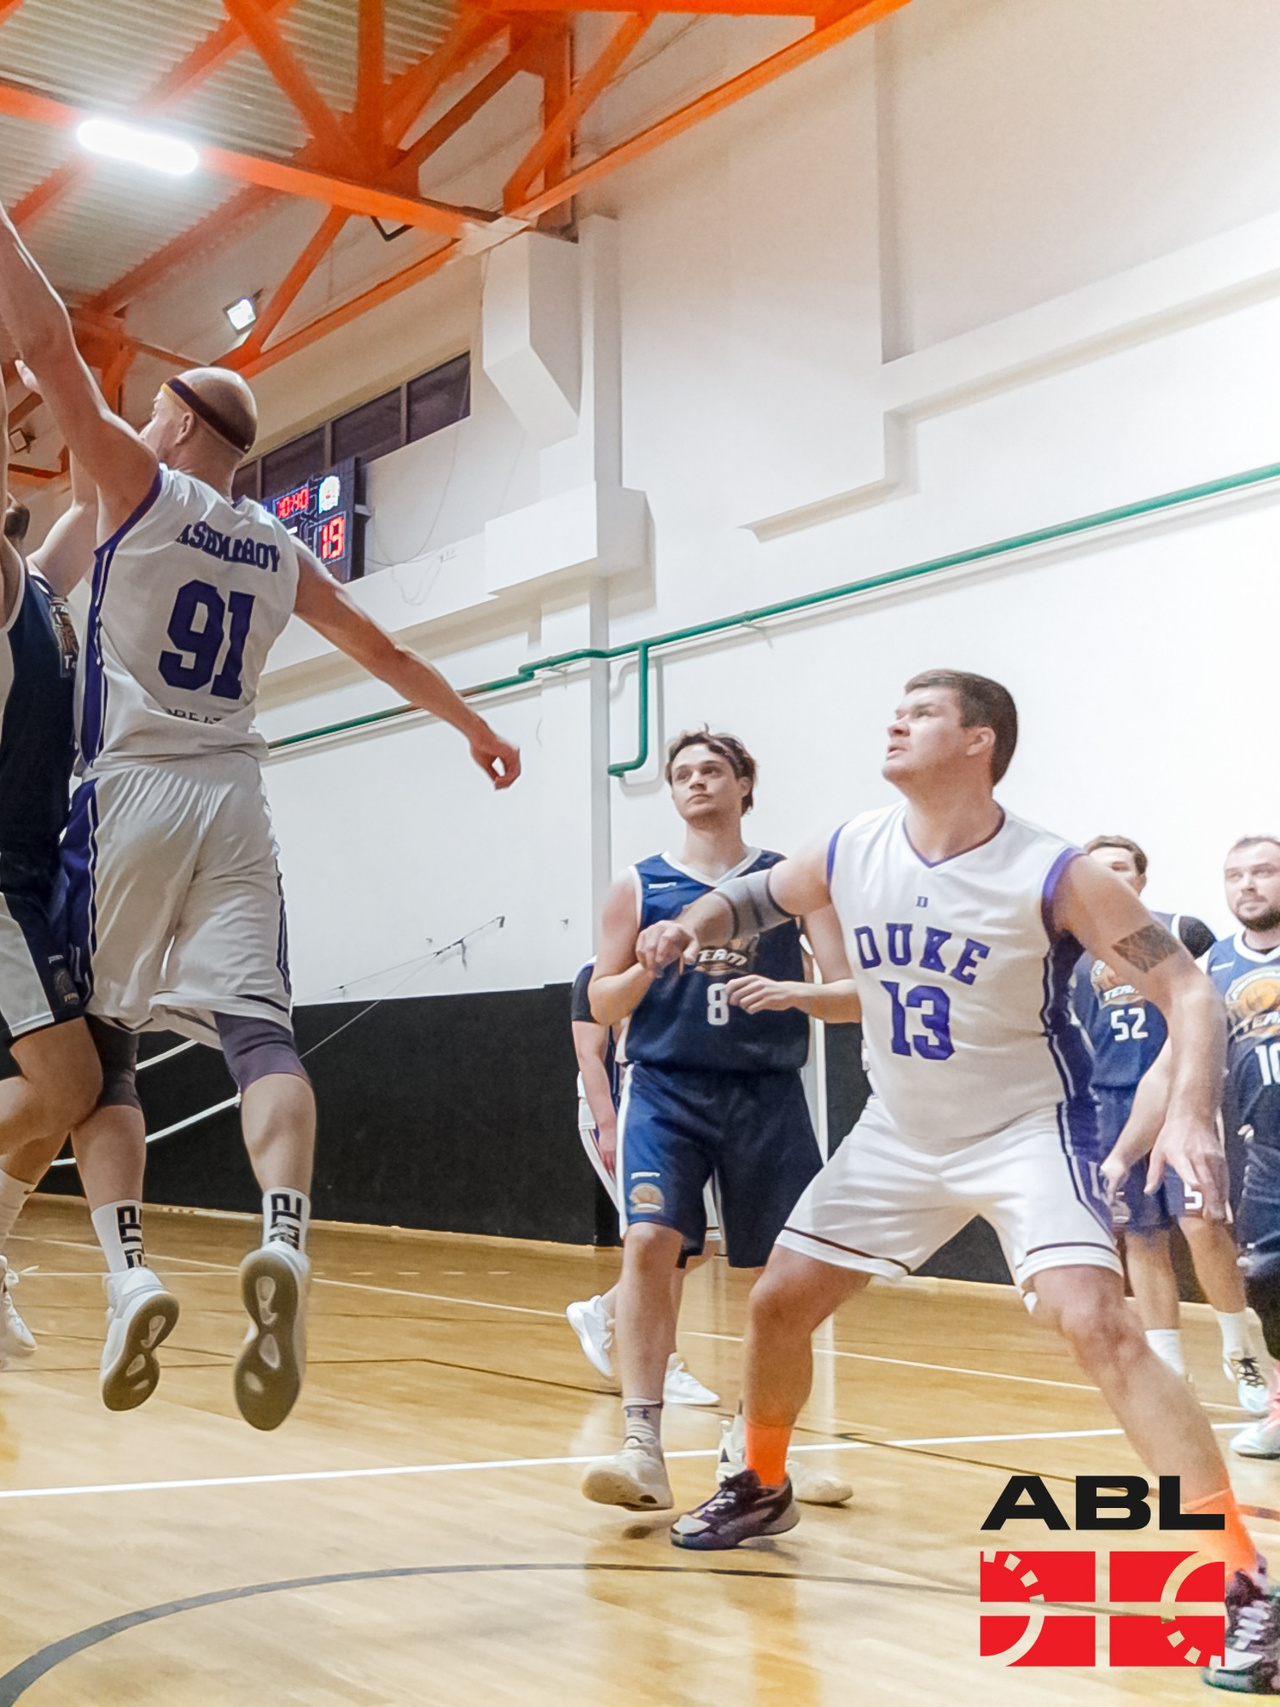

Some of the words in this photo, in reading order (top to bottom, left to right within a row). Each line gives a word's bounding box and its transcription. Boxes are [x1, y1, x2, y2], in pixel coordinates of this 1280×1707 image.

[158, 579, 256, 700] 91
[854, 923, 991, 986] DUKE
[707, 983, 730, 1026] 8
[880, 980, 956, 1061] 13
[1110, 1007, 1149, 1042] 52
